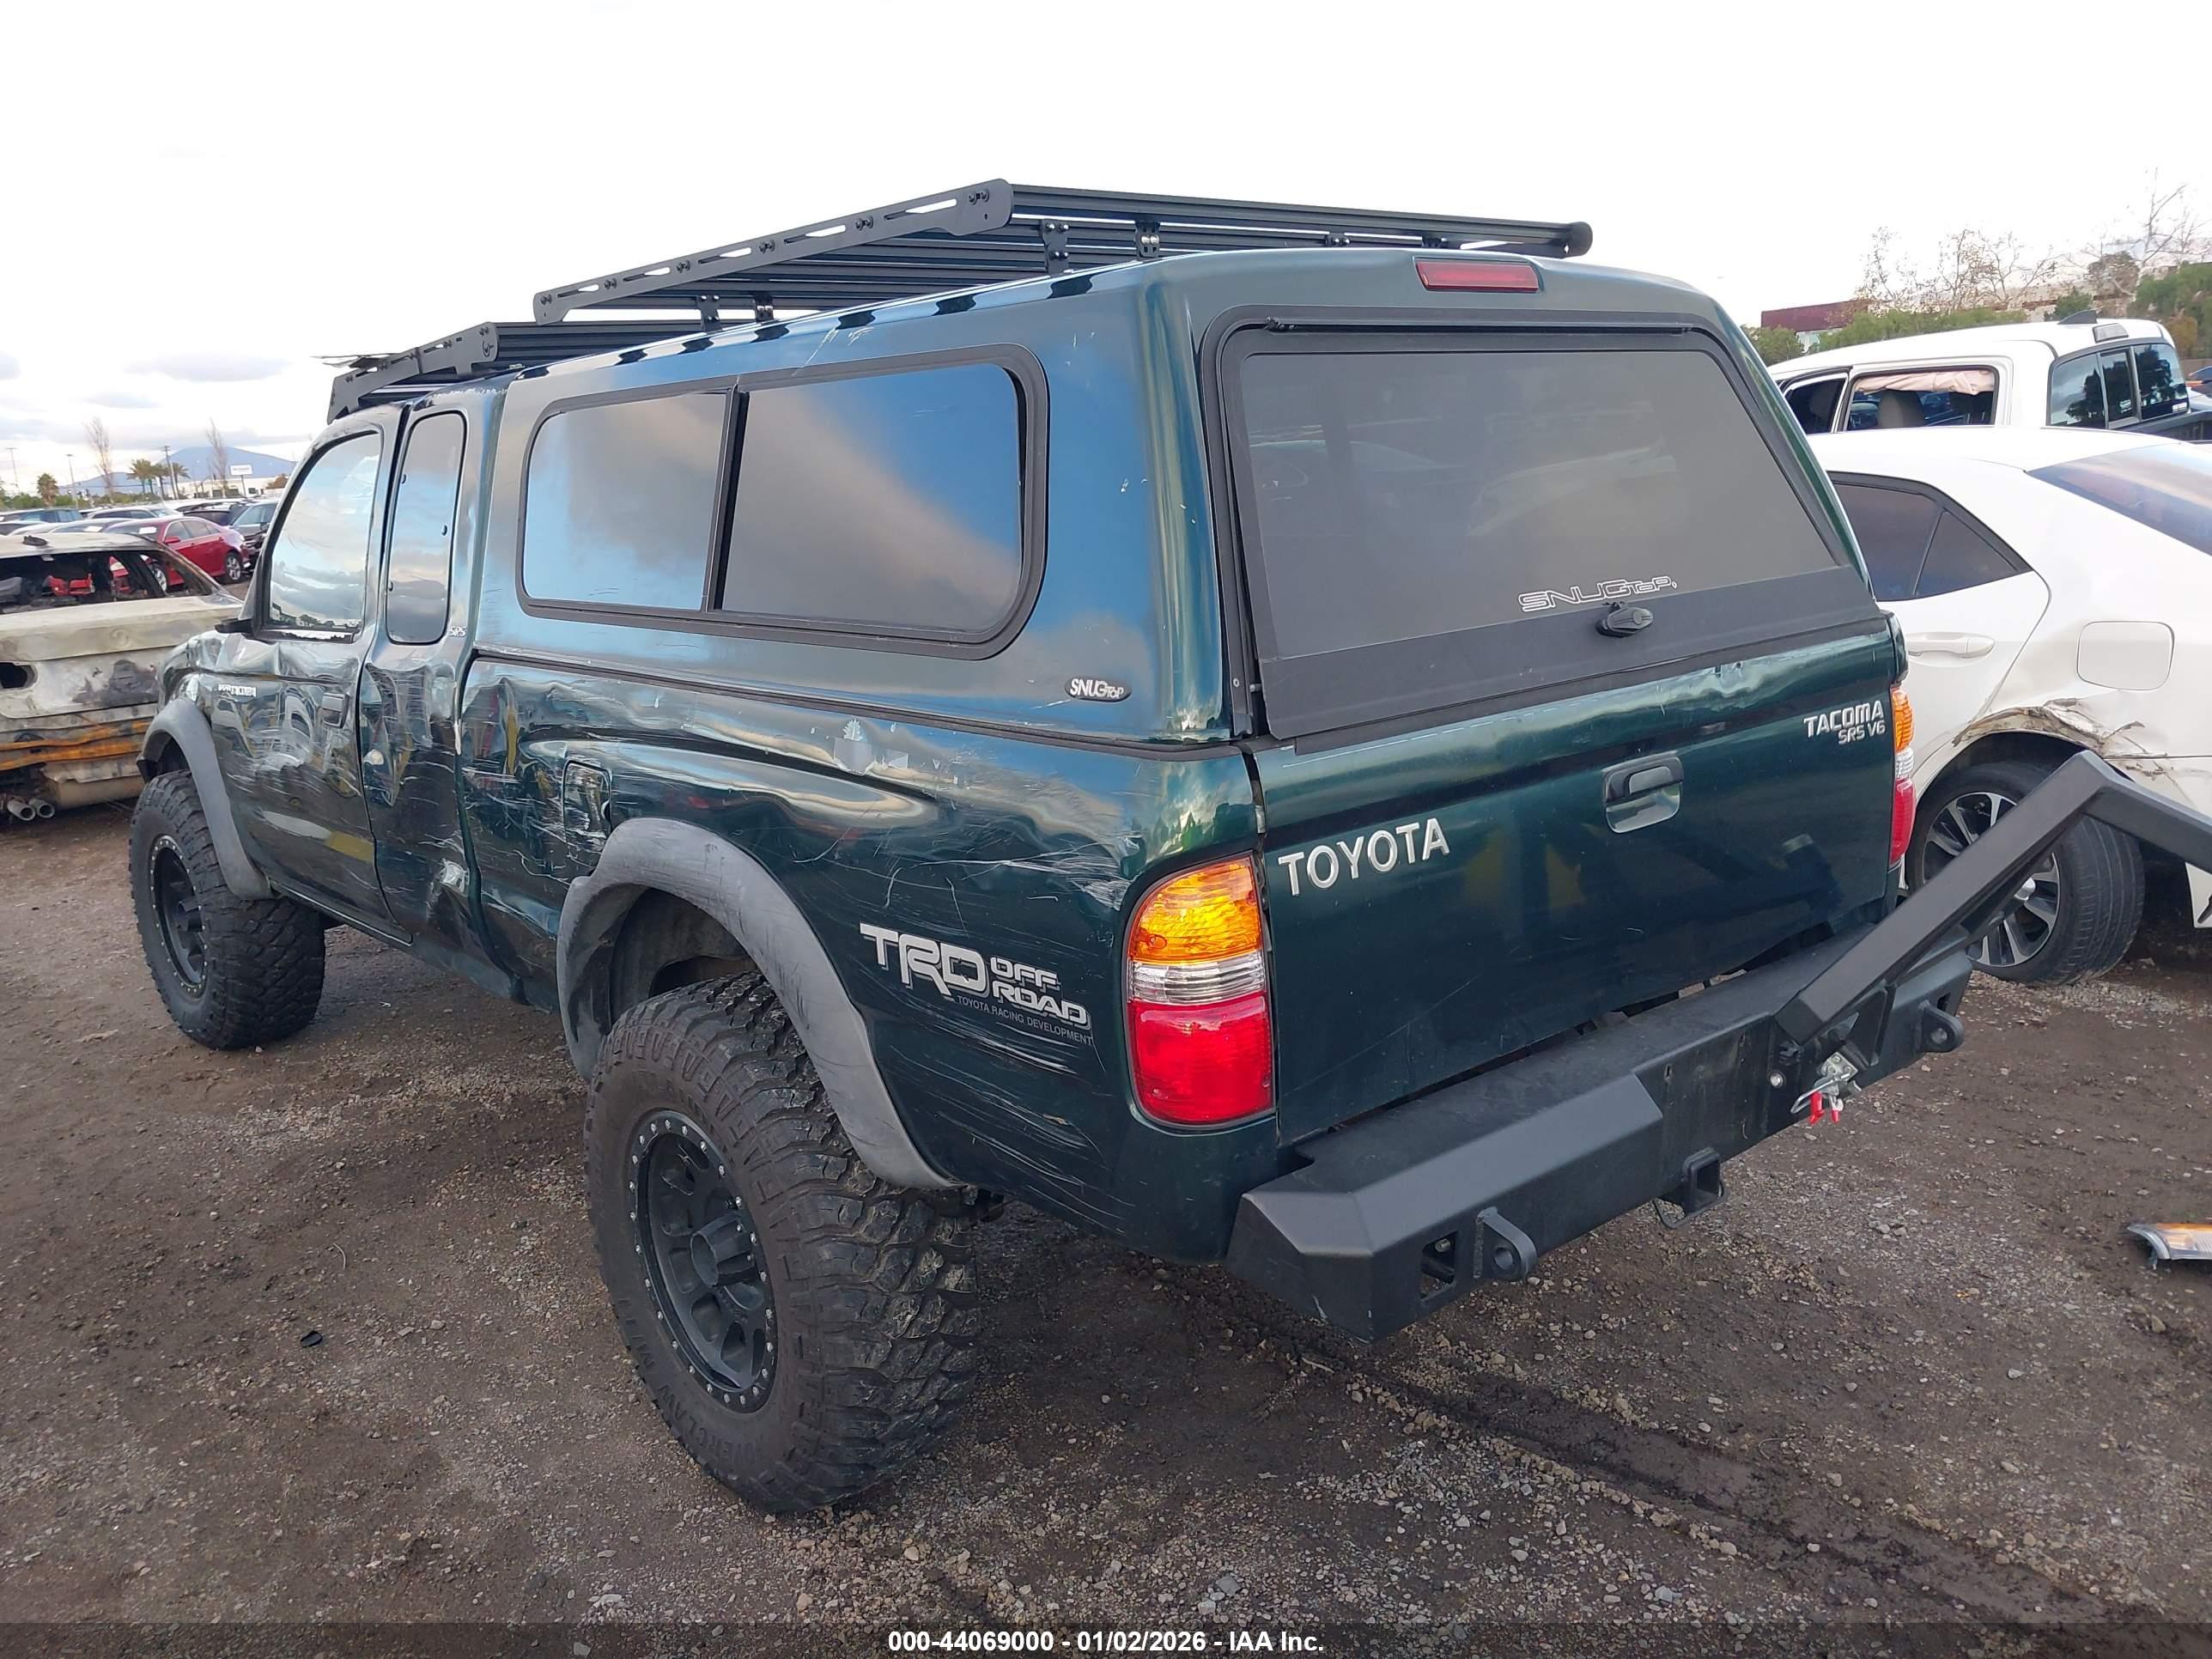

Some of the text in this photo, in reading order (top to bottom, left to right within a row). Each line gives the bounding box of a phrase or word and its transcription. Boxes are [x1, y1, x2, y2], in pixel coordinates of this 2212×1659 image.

[1803, 700, 1884, 738] TACOMA
[1838, 720, 1886, 745] SR5 V6
[1278, 817, 1450, 896] TOYOTA
[860, 923, 988, 1002] TRD
[990, 955, 1060, 991] OFF
[957, 994, 1093, 1046] TOYOTA RACING DEVELOPMENT
[992, 981, 1091, 1030] ROAD
